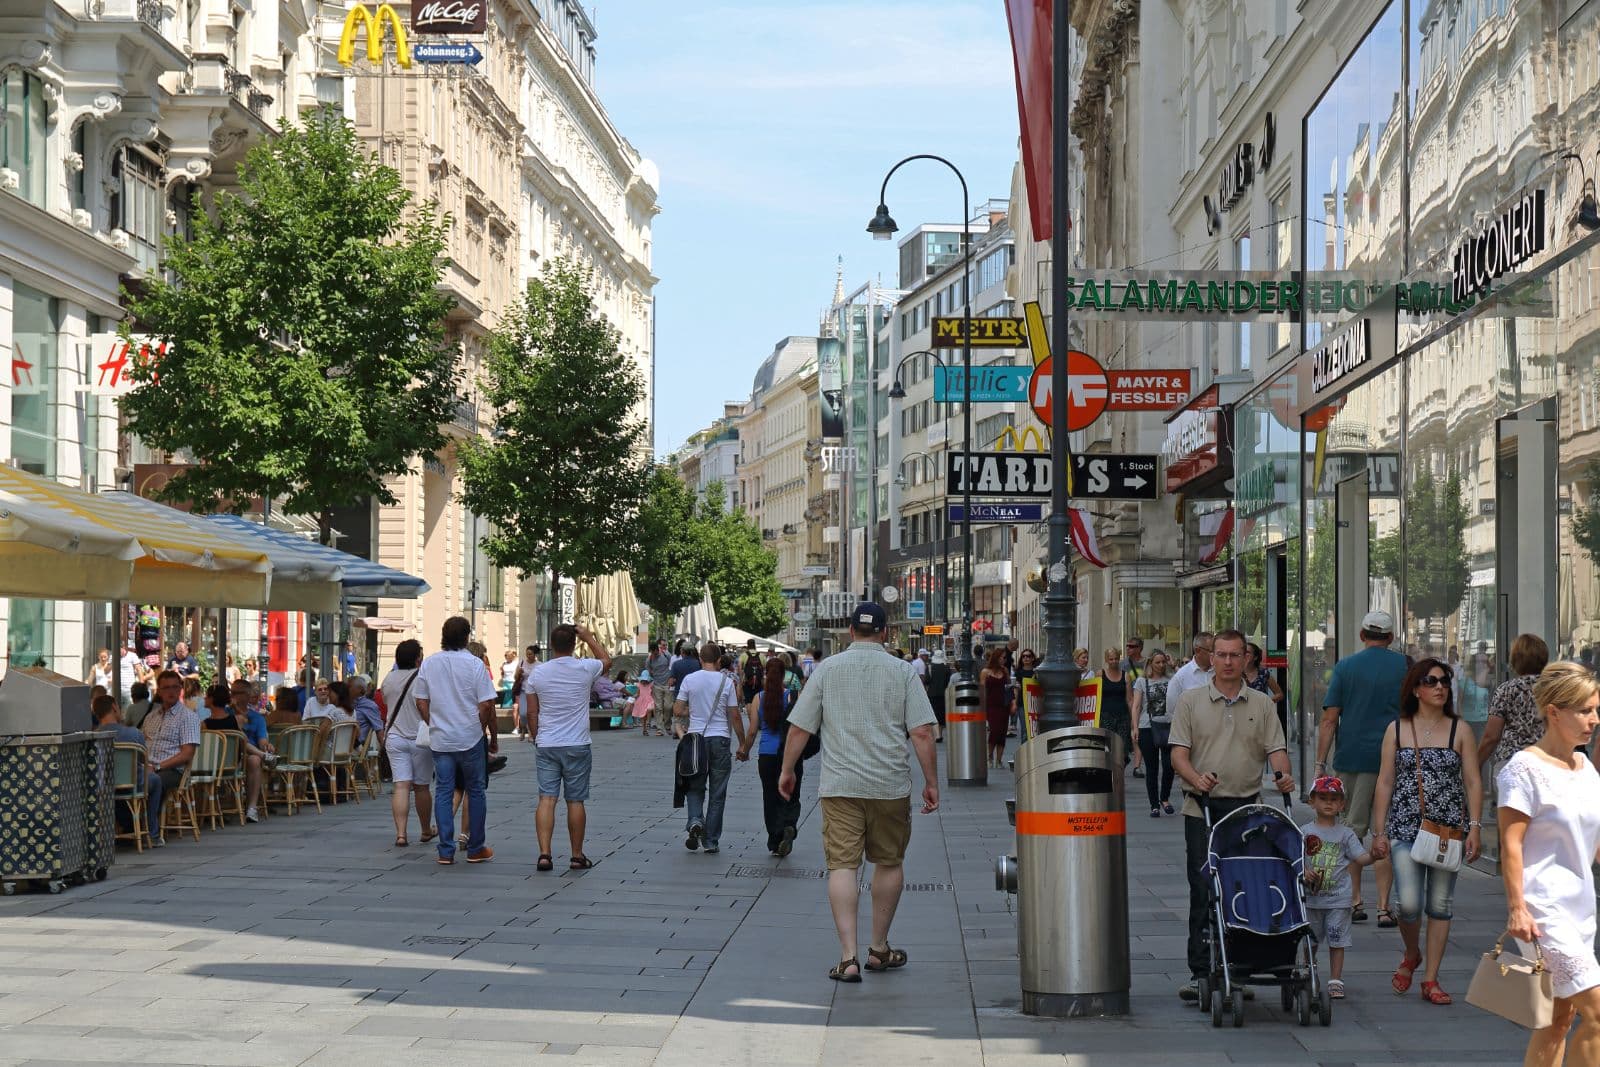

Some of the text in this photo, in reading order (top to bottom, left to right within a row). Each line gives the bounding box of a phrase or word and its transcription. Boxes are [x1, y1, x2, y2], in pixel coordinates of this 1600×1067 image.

[1452, 190, 1541, 304] FALCONERI
[1312, 318, 1368, 393] CALZEDONIA
[1111, 392, 1189, 404] FESSLER
[1117, 376, 1182, 388] MAYR &
[953, 456, 1154, 493] TARD'S 1. Stock
